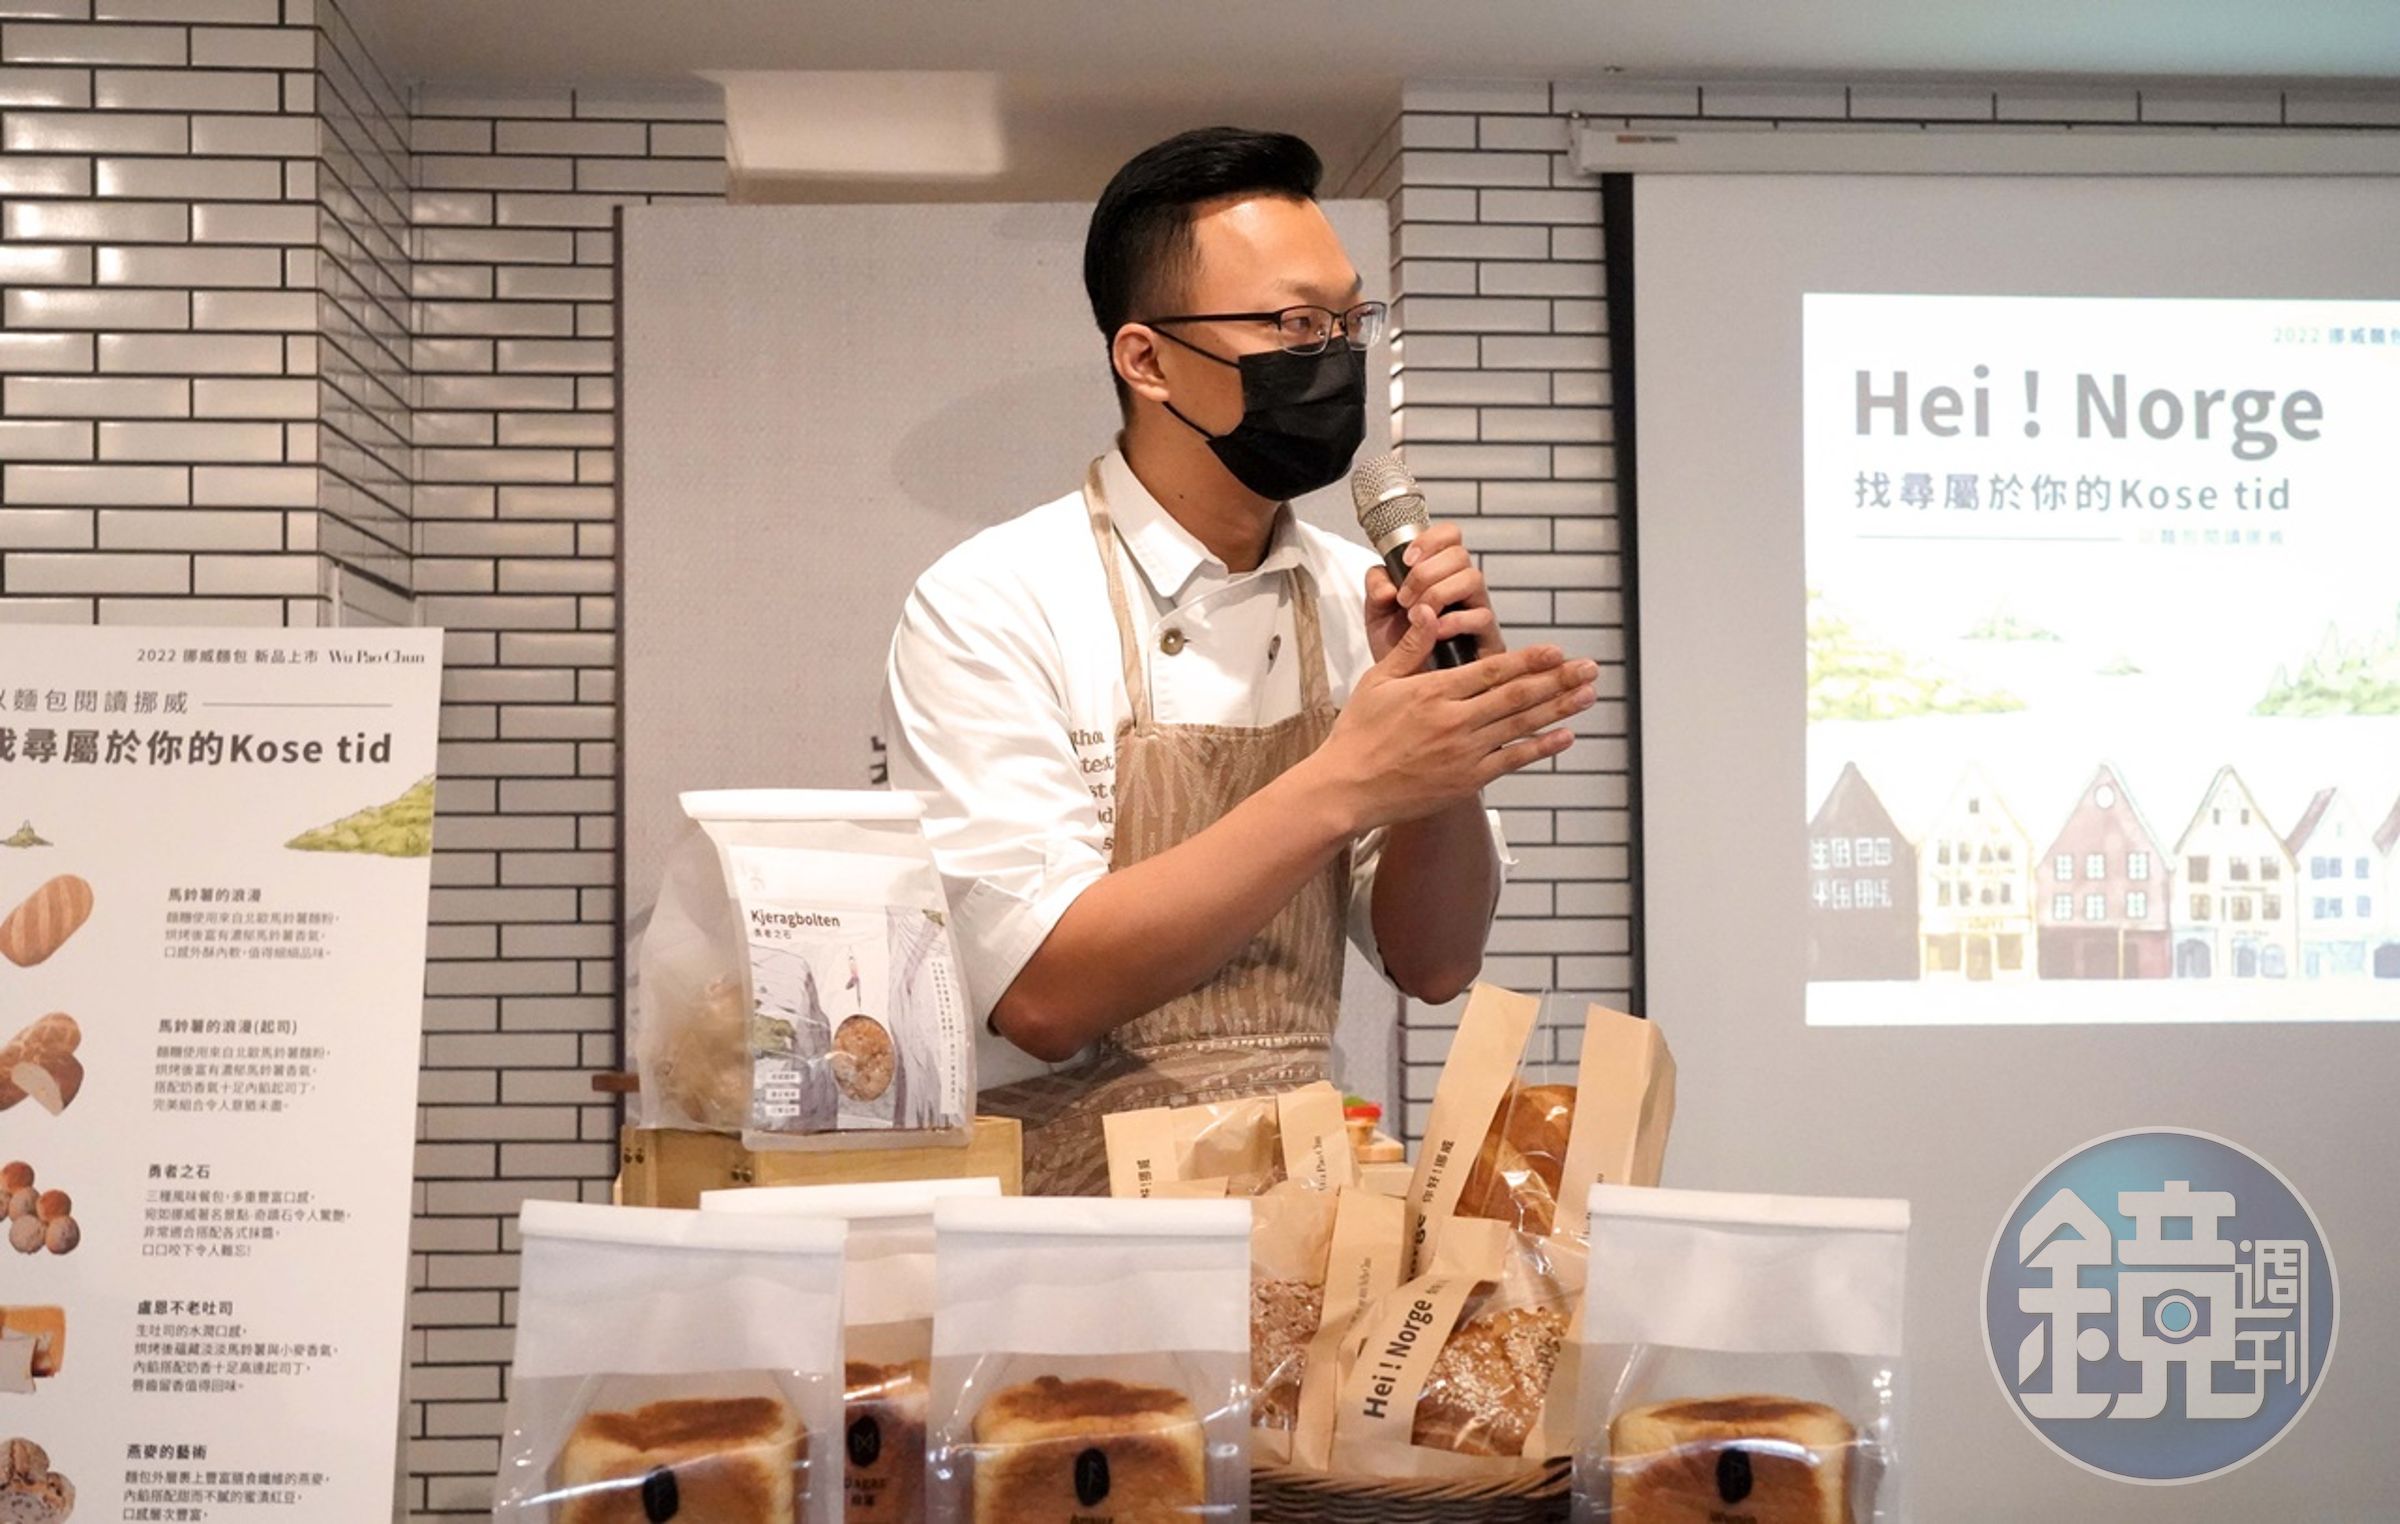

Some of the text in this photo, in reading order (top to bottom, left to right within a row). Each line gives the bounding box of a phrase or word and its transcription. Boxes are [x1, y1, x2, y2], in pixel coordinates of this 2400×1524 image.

[2274, 327, 2320, 344] 2022
[1856, 364, 1989, 437] Hei
[2077, 374, 2323, 461] Norge
[1855, 471, 2289, 511] 找尋屬於你的Kose tid
[137, 649, 424, 664] 2022 挪威麵包 新品上市 Wu Pao Chun
[0, 689, 187, 714] 麵包閱讀挪威
[337, 732, 391, 763] tid
[168, 888, 261, 902] 馬鈴薯的浪漫
[750, 909, 841, 928] Kjeragbolten
[149, 1164, 209, 1179] 勇者之石
[138, 1300, 232, 1316] 盧恩不老吐司
[1363, 1375, 1396, 1419] Hei
[1390, 1299, 1433, 1358] Norge
[127, 1444, 206, 1460] 燕麥的藝術
